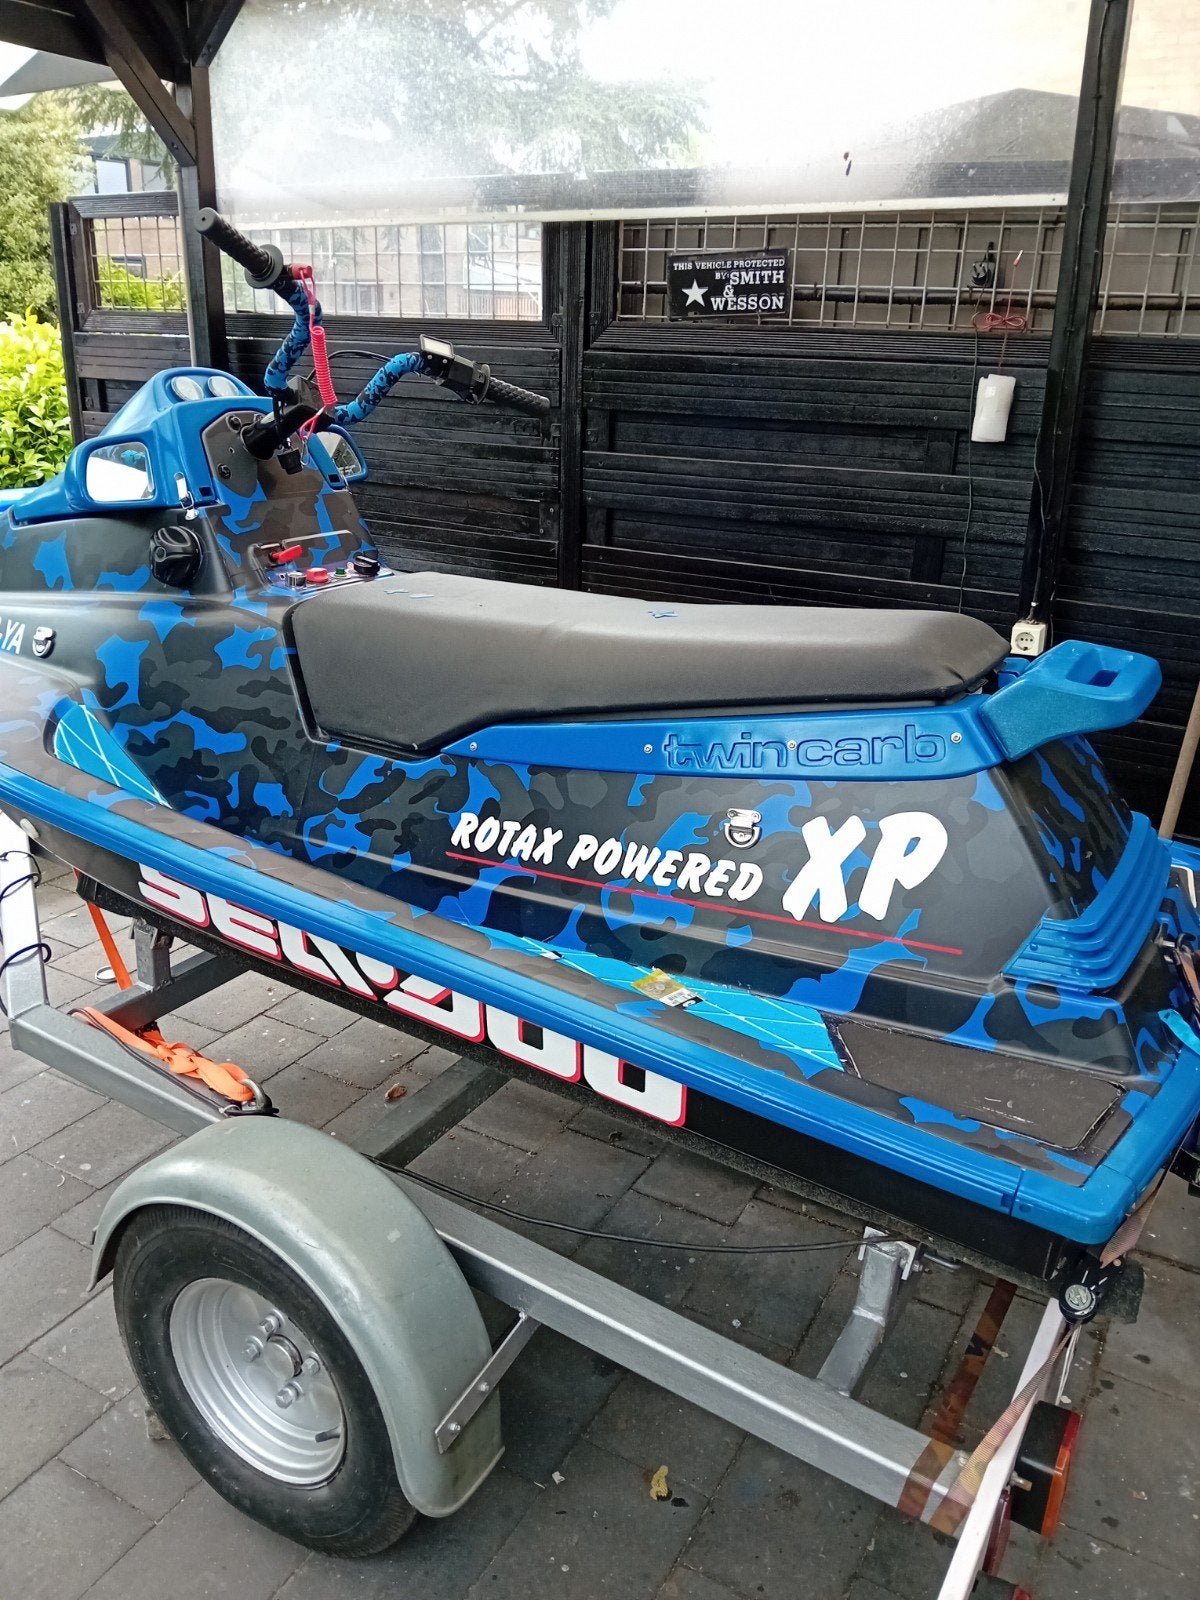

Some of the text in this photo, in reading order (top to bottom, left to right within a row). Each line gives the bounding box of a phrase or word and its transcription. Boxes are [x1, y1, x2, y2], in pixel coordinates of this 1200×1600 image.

[673, 258, 785, 270] THIS VEHICLE PROTECTED
[730, 270, 785, 285] SMITH
[723, 284, 735, 298] &
[711, 296, 784, 311] WESSON
[450, 811, 948, 923] ROTAX POWERED XP
